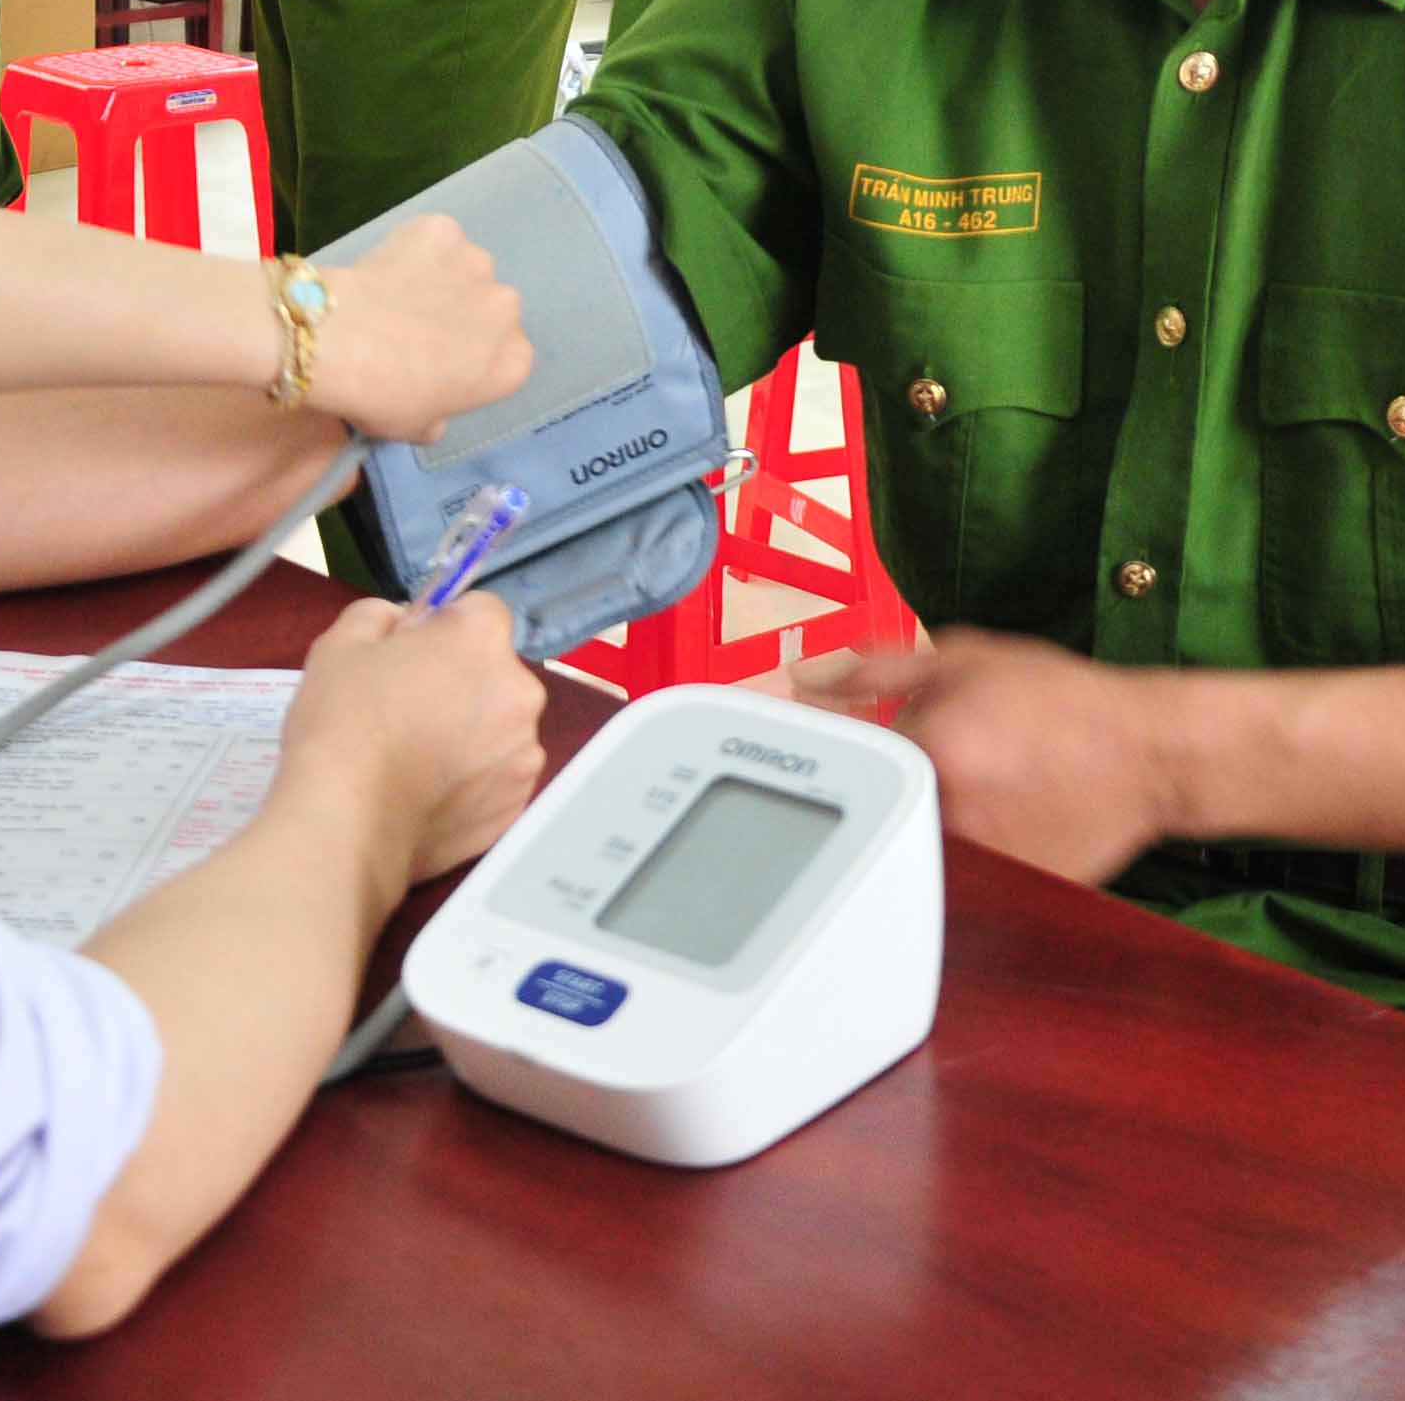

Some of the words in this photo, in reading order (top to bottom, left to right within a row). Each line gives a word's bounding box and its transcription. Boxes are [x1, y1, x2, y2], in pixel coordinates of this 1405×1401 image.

[913, 188, 965, 209] MINH
[971, 183, 1033, 205] TRUNG
[898, 208, 937, 230] A16
[958, 210, 997, 230] 462
